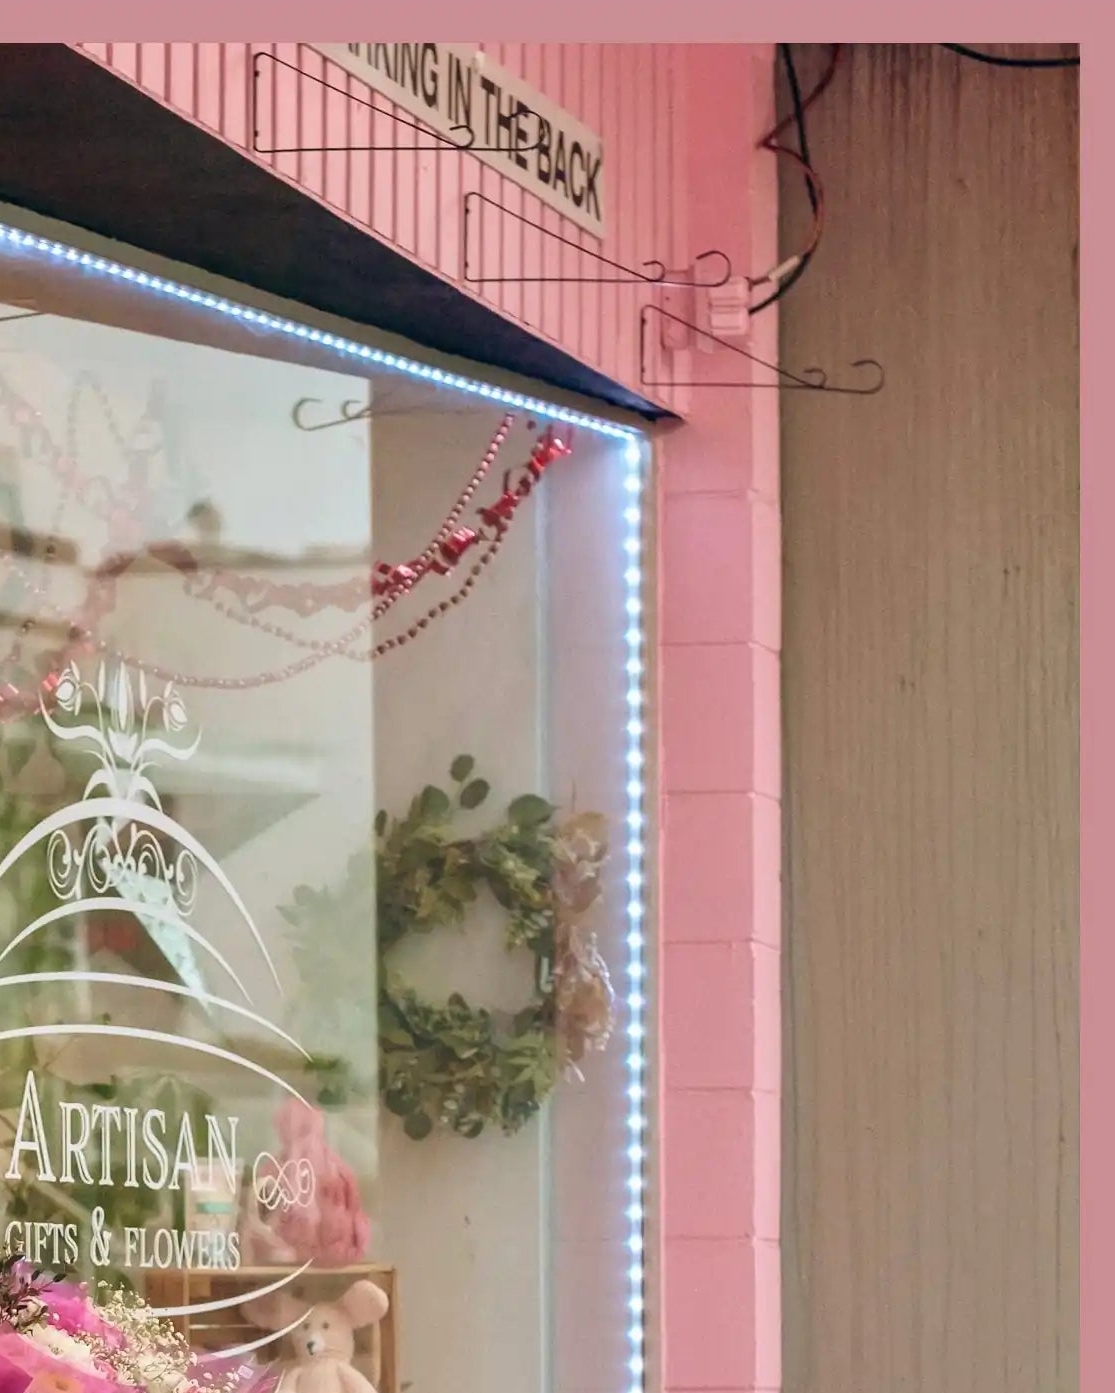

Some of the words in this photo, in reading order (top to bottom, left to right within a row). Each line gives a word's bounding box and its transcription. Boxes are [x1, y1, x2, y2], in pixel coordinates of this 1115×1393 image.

[348, 43, 439, 109] KING
[448, 52, 471, 128] IN
[480, 76, 529, 171] THE
[537, 116, 601, 222] BACK
[5, 1070, 240, 1194] ARTISAN
[4, 1221, 78, 1265] GIFTS
[90, 1206, 112, 1266] &
[125, 1227, 241, 1271] FLOWERS
